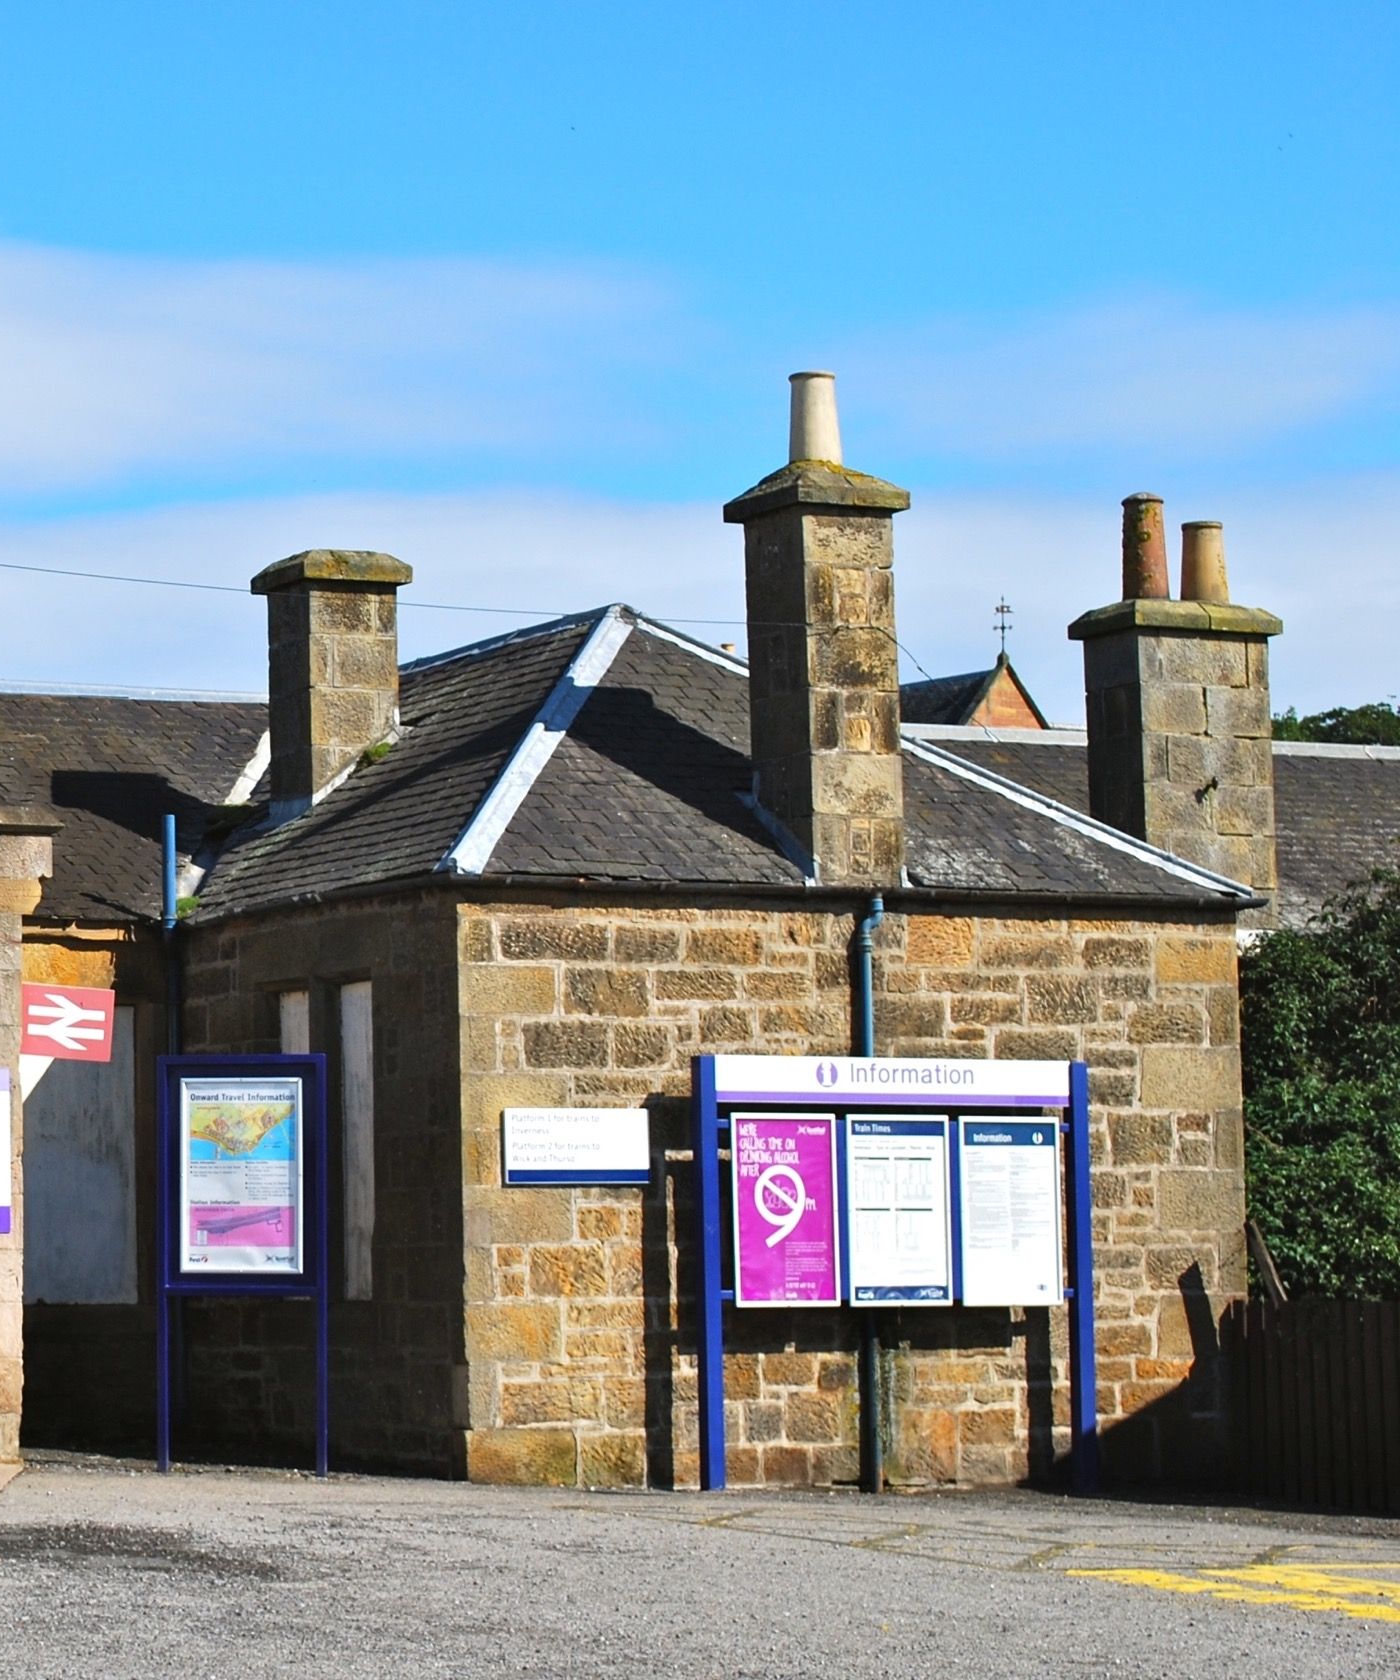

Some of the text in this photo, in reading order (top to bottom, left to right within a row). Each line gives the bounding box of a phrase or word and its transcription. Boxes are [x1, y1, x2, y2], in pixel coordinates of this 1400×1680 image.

[850, 1063, 974, 1085] Information
[190, 1093, 296, 1101] Onward Travel Information
[511, 1114, 545, 1122] Platform
[553, 1114, 564, 1122] for
[591, 1115, 600, 1123] to
[511, 1127, 549, 1135] Inverness
[854, 1123, 891, 1133] Train Times
[973, 1132, 1012, 1143] Information
[512, 1142, 546, 1151] Platform
[554, 1142, 565, 1151] for
[591, 1143, 600, 1151] to
